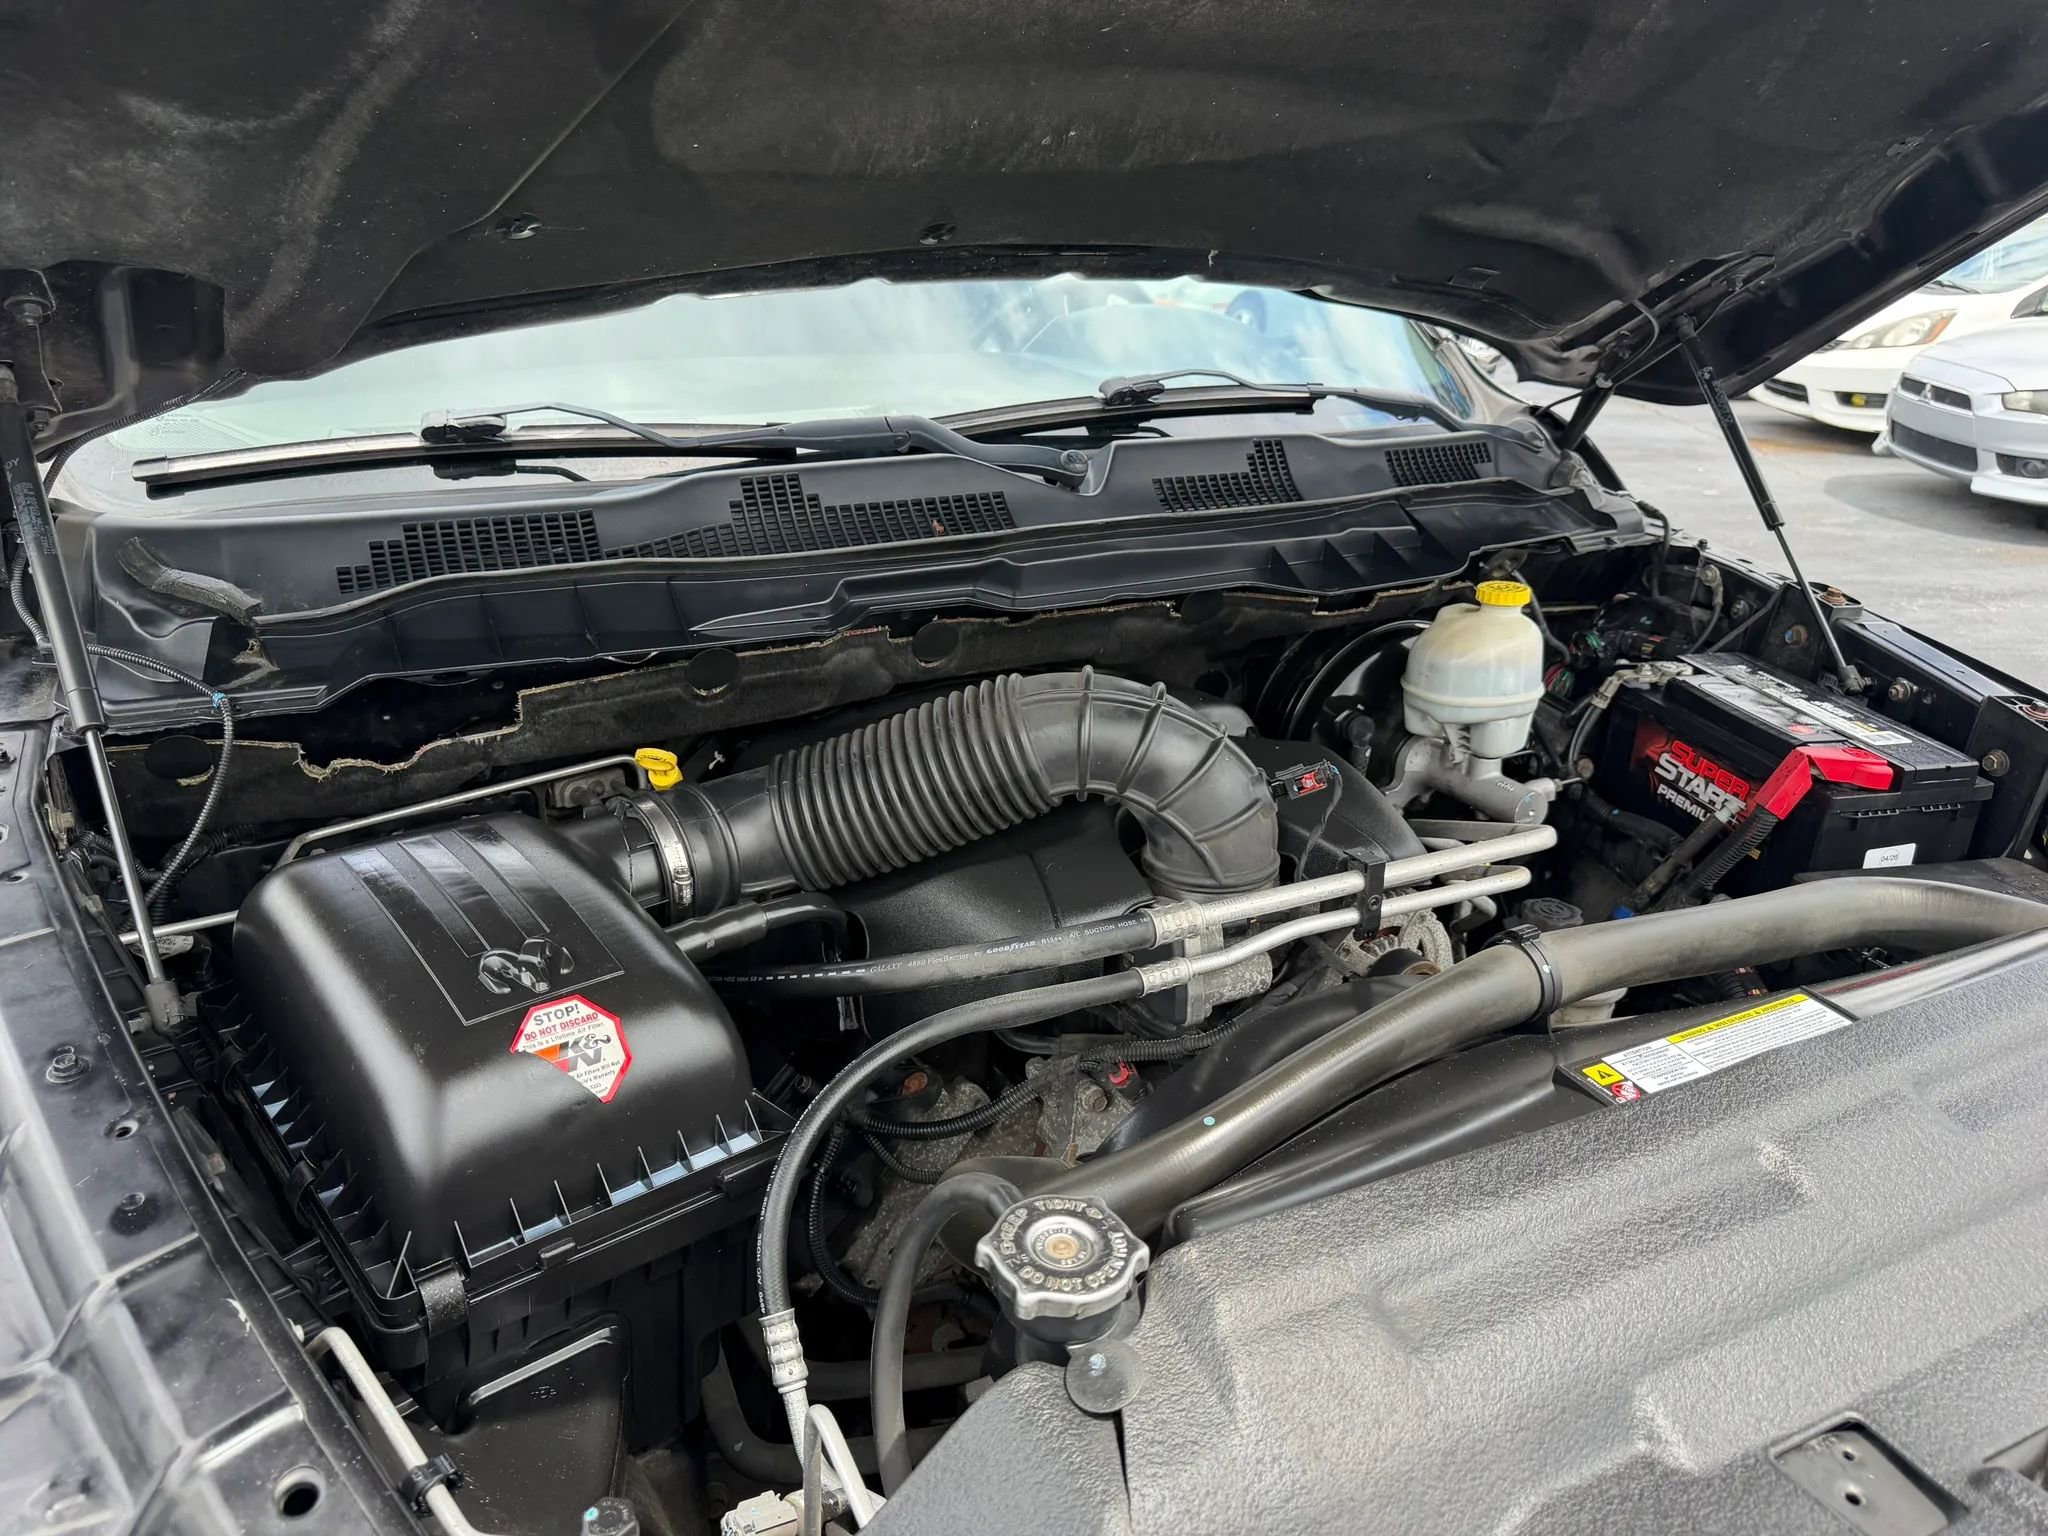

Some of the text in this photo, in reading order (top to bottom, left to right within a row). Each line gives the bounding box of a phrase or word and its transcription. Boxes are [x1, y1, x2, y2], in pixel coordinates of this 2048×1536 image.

[1654, 752, 1746, 812] START
[1671, 740, 1750, 801] SUPER
[1657, 783, 1712, 822] PREMIU
[870, 962, 902, 973] GALAXY
[927, 953, 970, 965] FlexBarrier
[986, 940, 1037, 954] GOODYEAR
[1084, 924, 1115, 936] SUCTION
[1118, 919, 1138, 928] HOSE
[524, 1012, 599, 1042] DO NOT DISCARD
[533, 1003, 581, 1026] STOP!
[551, 1031, 576, 1043] Lifetime
[593, 1069, 616, 1081] Warranty
[1001, 1207, 1028, 1241] KEEP
[1033, 1198, 1088, 1212] TIGHT
[1018, 1231, 1129, 1292] DO NOT OPEN HOT
